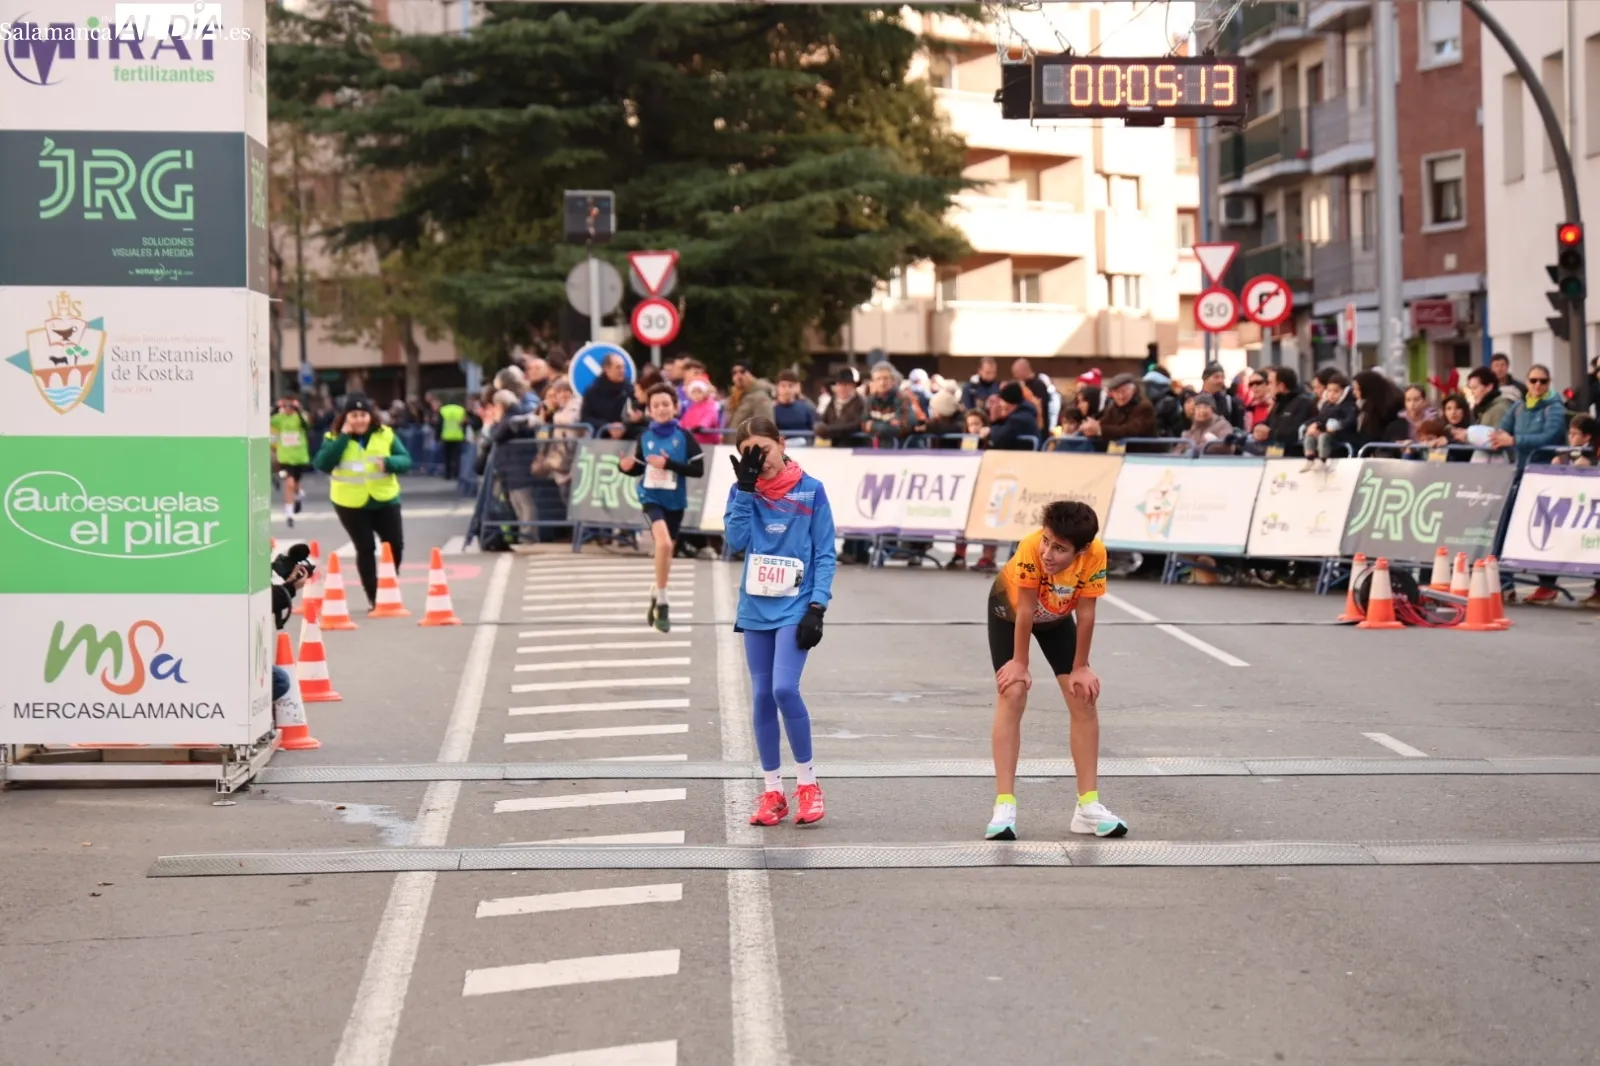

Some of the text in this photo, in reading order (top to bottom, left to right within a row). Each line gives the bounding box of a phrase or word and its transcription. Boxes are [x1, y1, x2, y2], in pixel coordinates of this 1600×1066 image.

[114, 65, 214, 83] fertilizantes
[38, 137, 194, 221] JRG
[141, 237, 194, 247] SOLUCIONES
[112, 248, 194, 258] VISUALES A MEDIDA
[1203, 302, 1230, 318] 30
[641, 313, 669, 331] 30
[111, 345, 234, 364] San Estanislao
[111, 364, 194, 382] de Kostka
[13, 487, 220, 513] autoescuelas
[1348, 468, 1452, 544] JRG
[70, 513, 220, 553] el pilar
[762, 557, 798, 568] SETEL
[758, 566, 785, 584] 6411
[13, 702, 225, 719] MERCASALAMANCA
